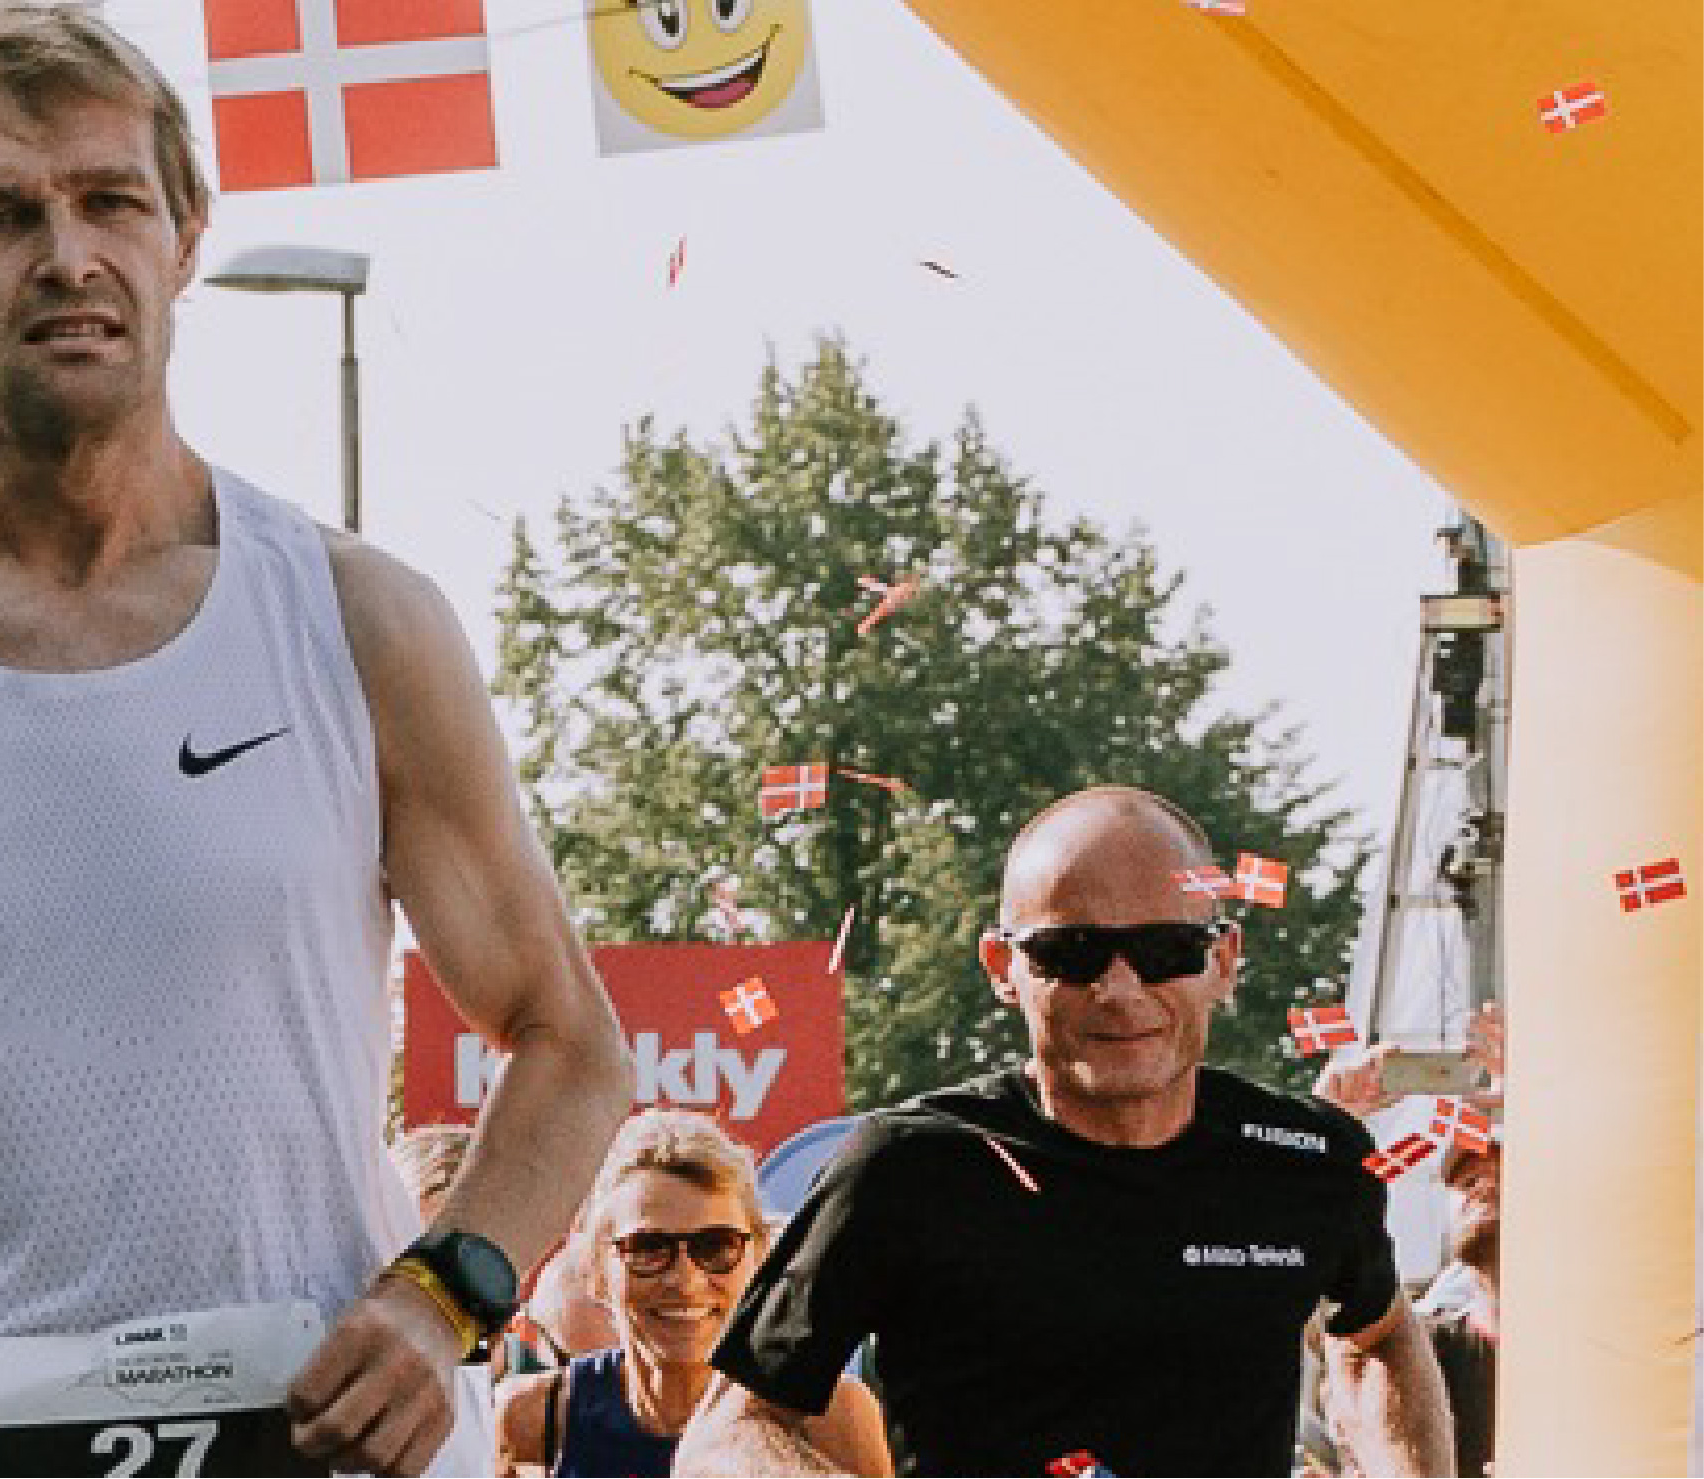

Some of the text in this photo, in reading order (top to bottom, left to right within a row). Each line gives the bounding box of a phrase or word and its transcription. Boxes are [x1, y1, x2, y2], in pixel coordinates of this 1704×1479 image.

[454, 1032, 787, 1120] Kkly
[116, 1365, 234, 1384] MARATHON
[90, 1420, 219, 1478] 27
